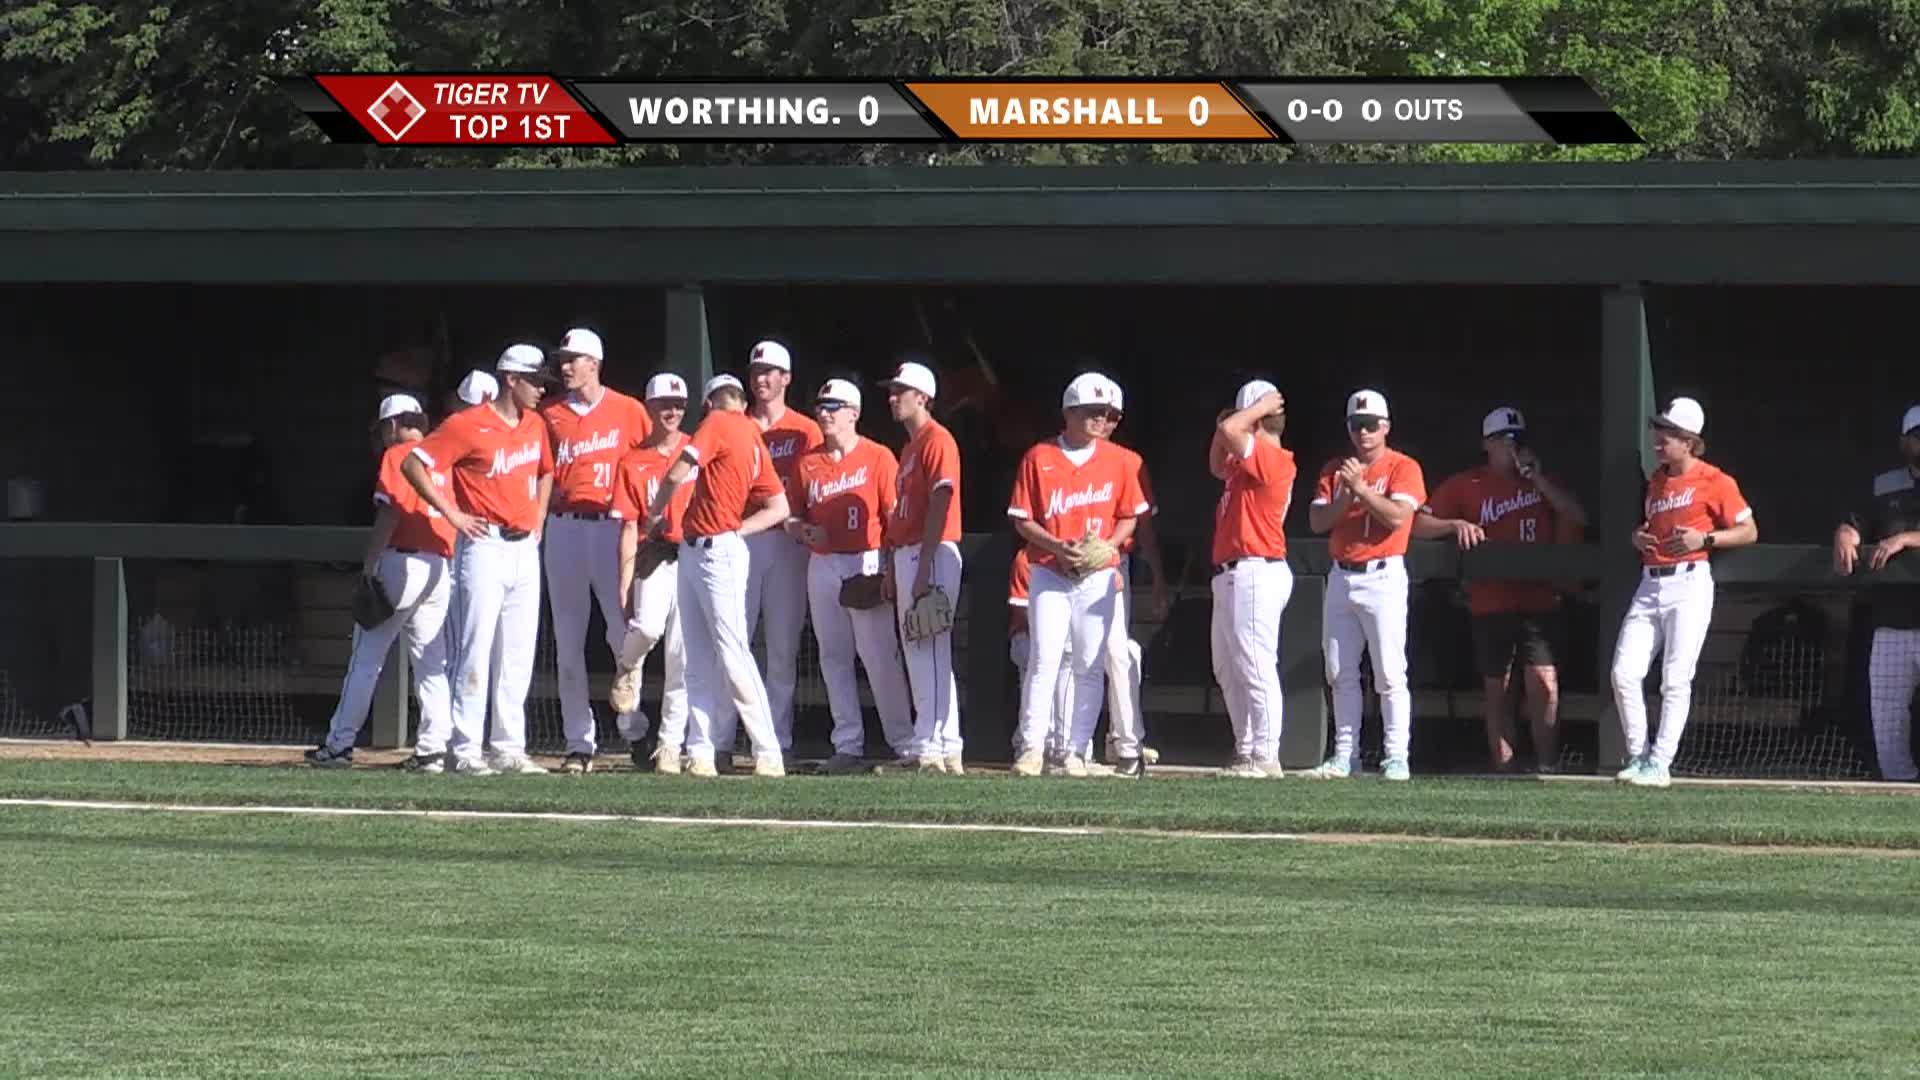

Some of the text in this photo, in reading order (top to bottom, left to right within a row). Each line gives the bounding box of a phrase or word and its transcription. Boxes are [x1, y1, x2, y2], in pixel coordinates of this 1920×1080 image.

[670, 380, 681, 393] M
[1356, 397, 1368, 410] M
[557, 429, 619, 468] Marshall
[593, 463, 611, 489] 21
[806, 465, 868, 509] Marshall
[1044, 482, 1114, 520] Marshall
[847, 506, 859, 530] 8
[1519, 518, 1537, 544] 13
